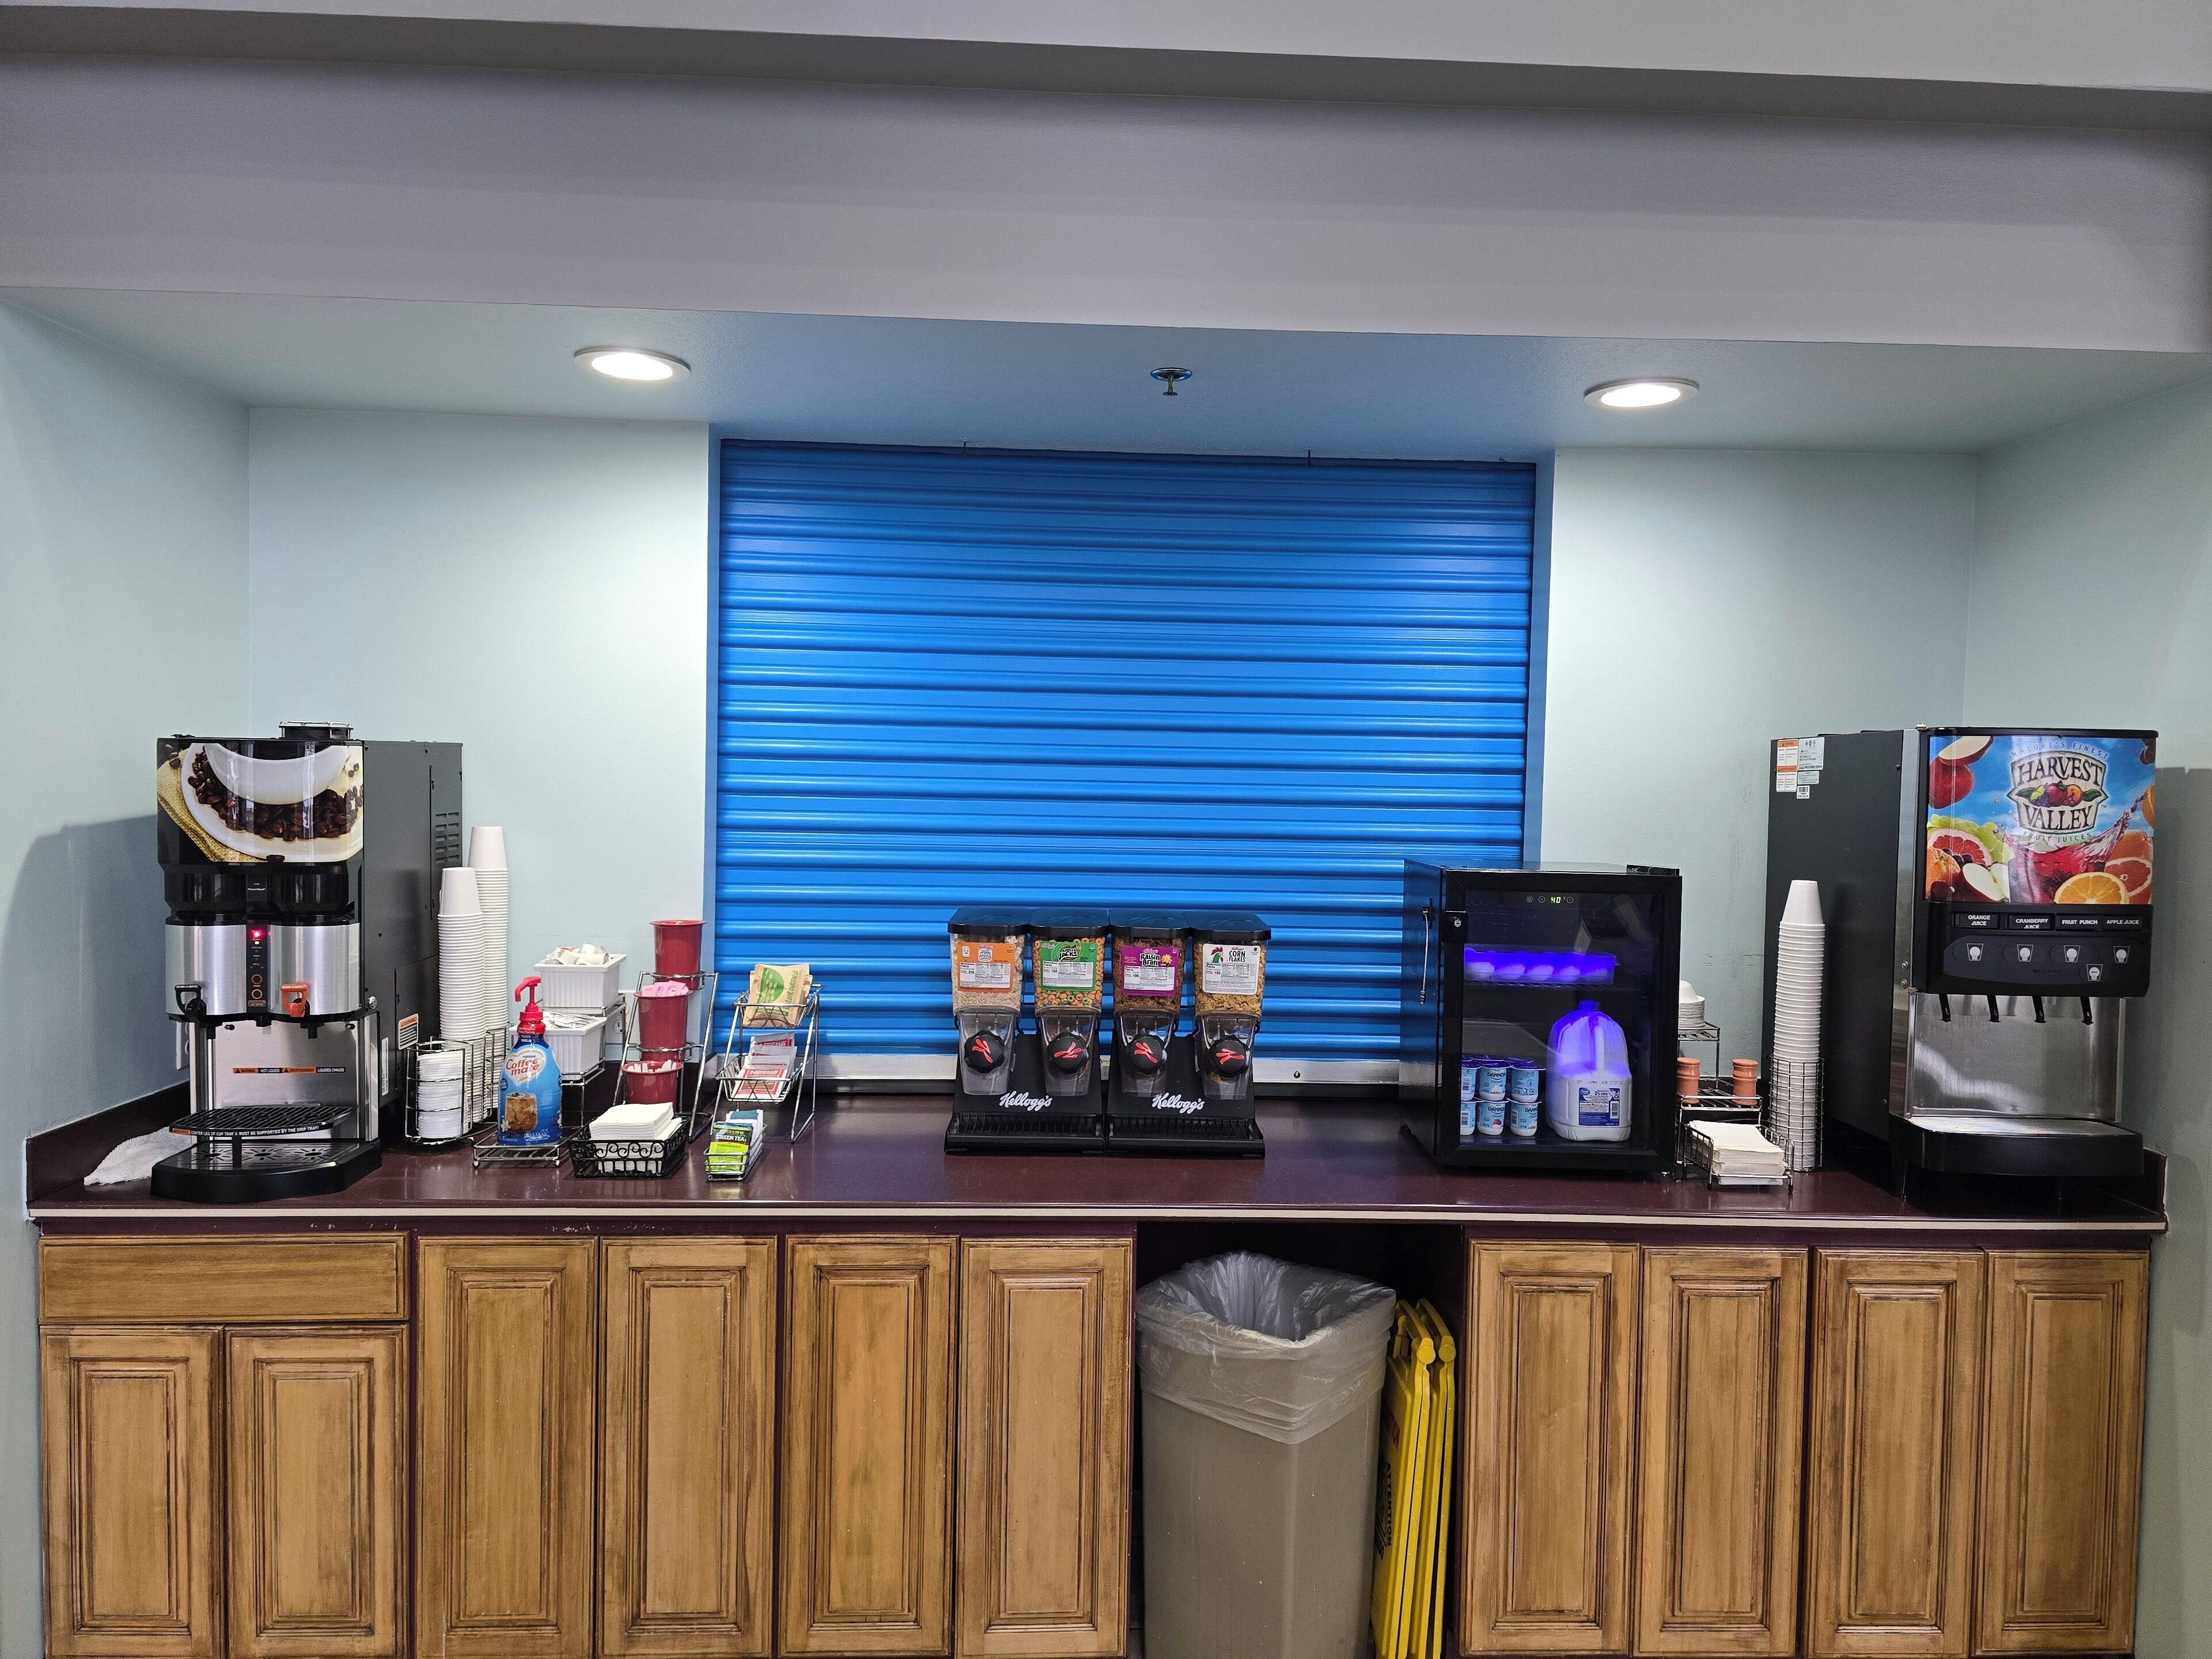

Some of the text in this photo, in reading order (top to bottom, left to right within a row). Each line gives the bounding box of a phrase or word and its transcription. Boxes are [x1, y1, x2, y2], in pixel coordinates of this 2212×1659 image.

[2012, 742, 2108, 760] NATURE'S FINEST
[2017, 756, 2104, 786] HARVEST
[2022, 802, 2093, 830] VALLEY
[2022, 832, 2092, 843] FRUIT JUICES
[790, 969, 798, 991] oatmeal
[506, 1059, 539, 1070] Coffee
[999, 1090, 1052, 1111] Kellogg's
[1152, 1092, 1205, 1114] Kellogg's
